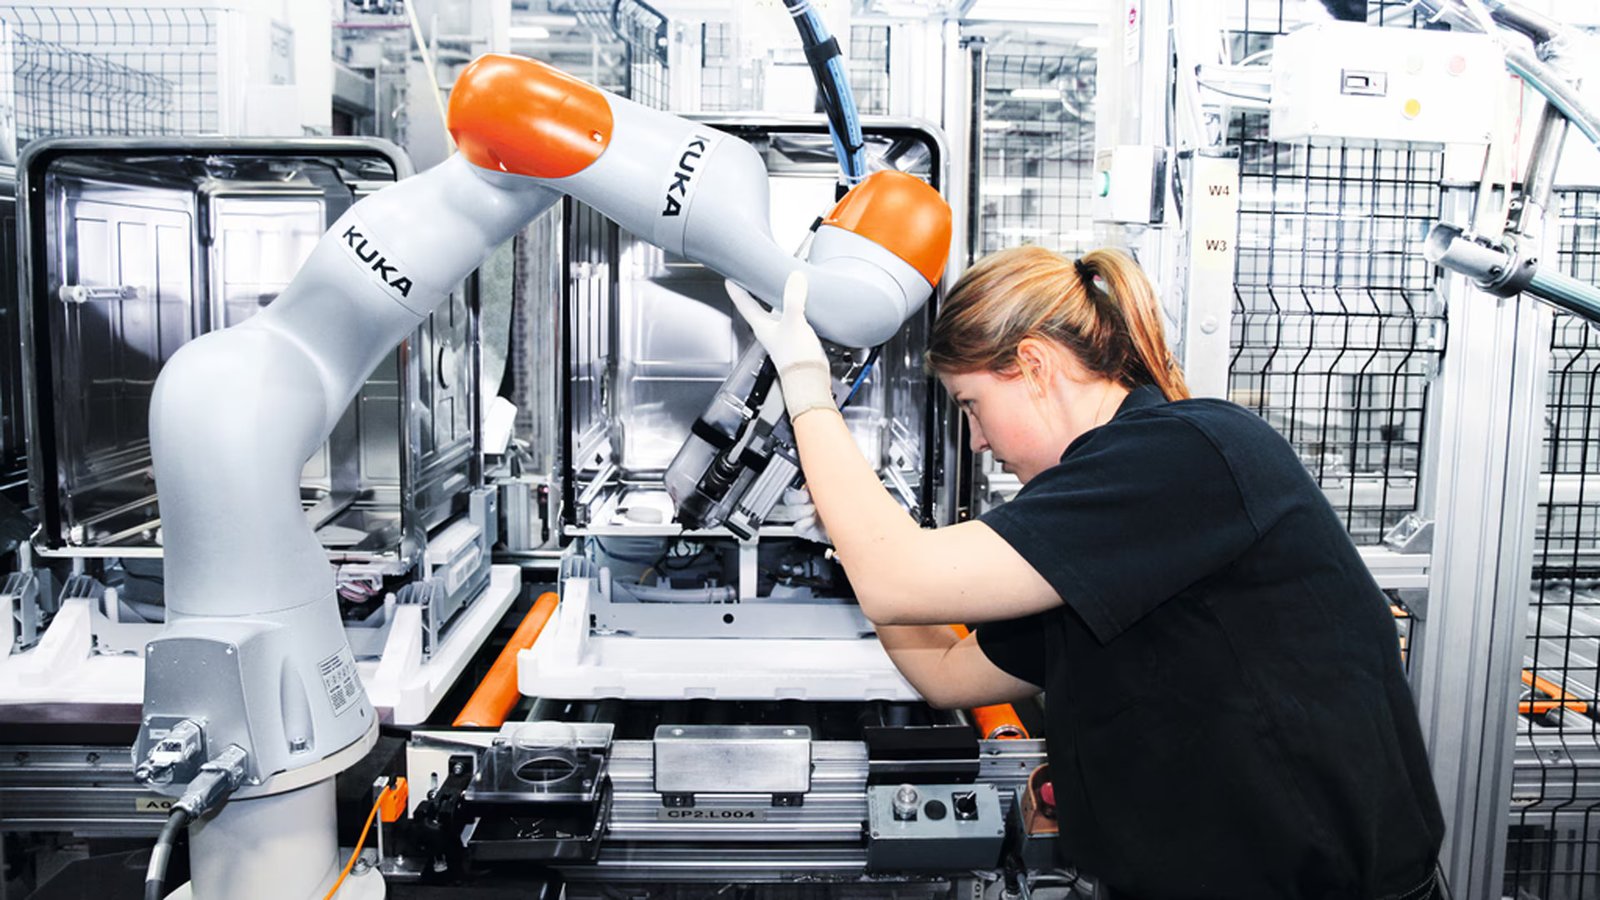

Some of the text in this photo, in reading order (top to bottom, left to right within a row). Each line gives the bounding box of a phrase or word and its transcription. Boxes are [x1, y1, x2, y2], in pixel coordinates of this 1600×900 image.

[662, 134, 711, 217] KUKA
[1209, 185, 1229, 196] W4
[1206, 240, 1227, 252] W3
[342, 225, 413, 298] KUKA
[667, 810, 755, 819] CP2.L004
